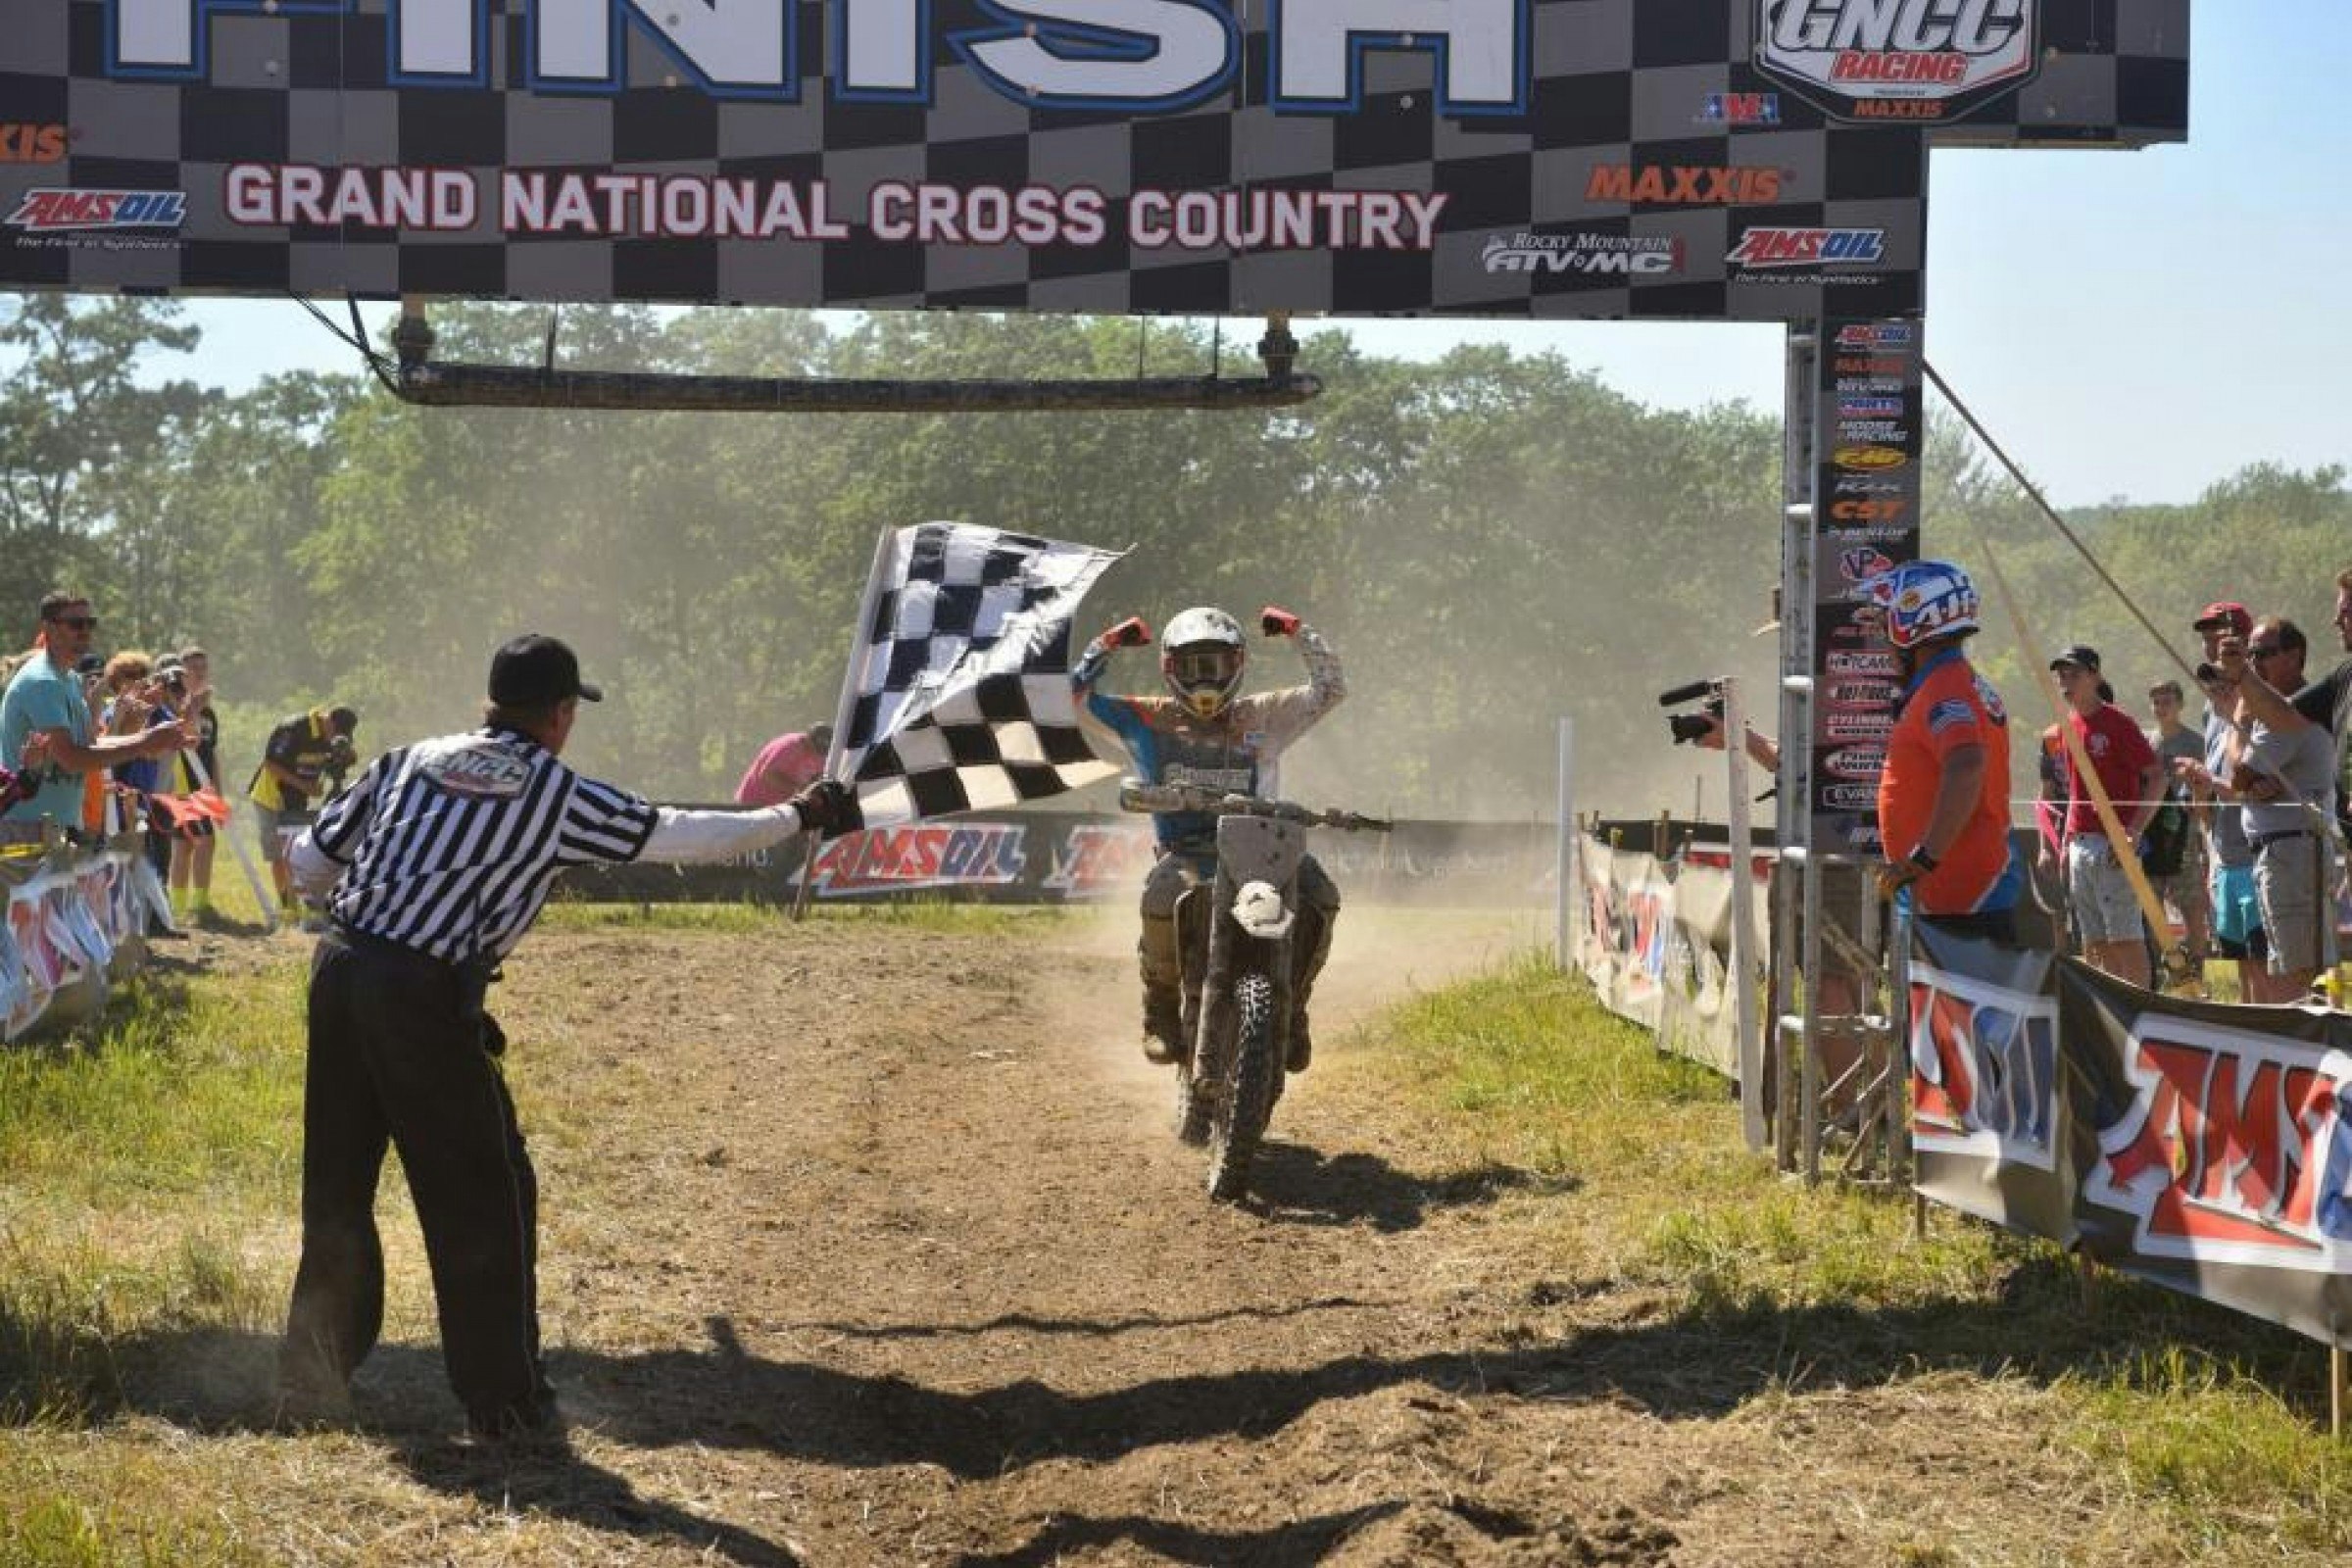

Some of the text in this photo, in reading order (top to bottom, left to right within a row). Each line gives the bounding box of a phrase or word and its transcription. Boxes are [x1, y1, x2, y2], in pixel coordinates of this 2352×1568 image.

[1772, 0, 2025, 53] GNCC
[1833, 51, 1968, 84] RACING
[1853, 98, 1944, 119] MAXXIS
[1584, 164, 1780, 206] MAXXIS
[4, 188, 186, 231] AMSOIL
[224, 163, 1449, 251] GRAND NATIONAL CROSS COUNTRY
[1513, 232, 1673, 253] ROCKY MOUNTAIN
[1726, 226, 1885, 269] AMSOIL
[1834, 788, 1879, 799] EVAN
[788, 824, 1025, 897] AMSOIL
